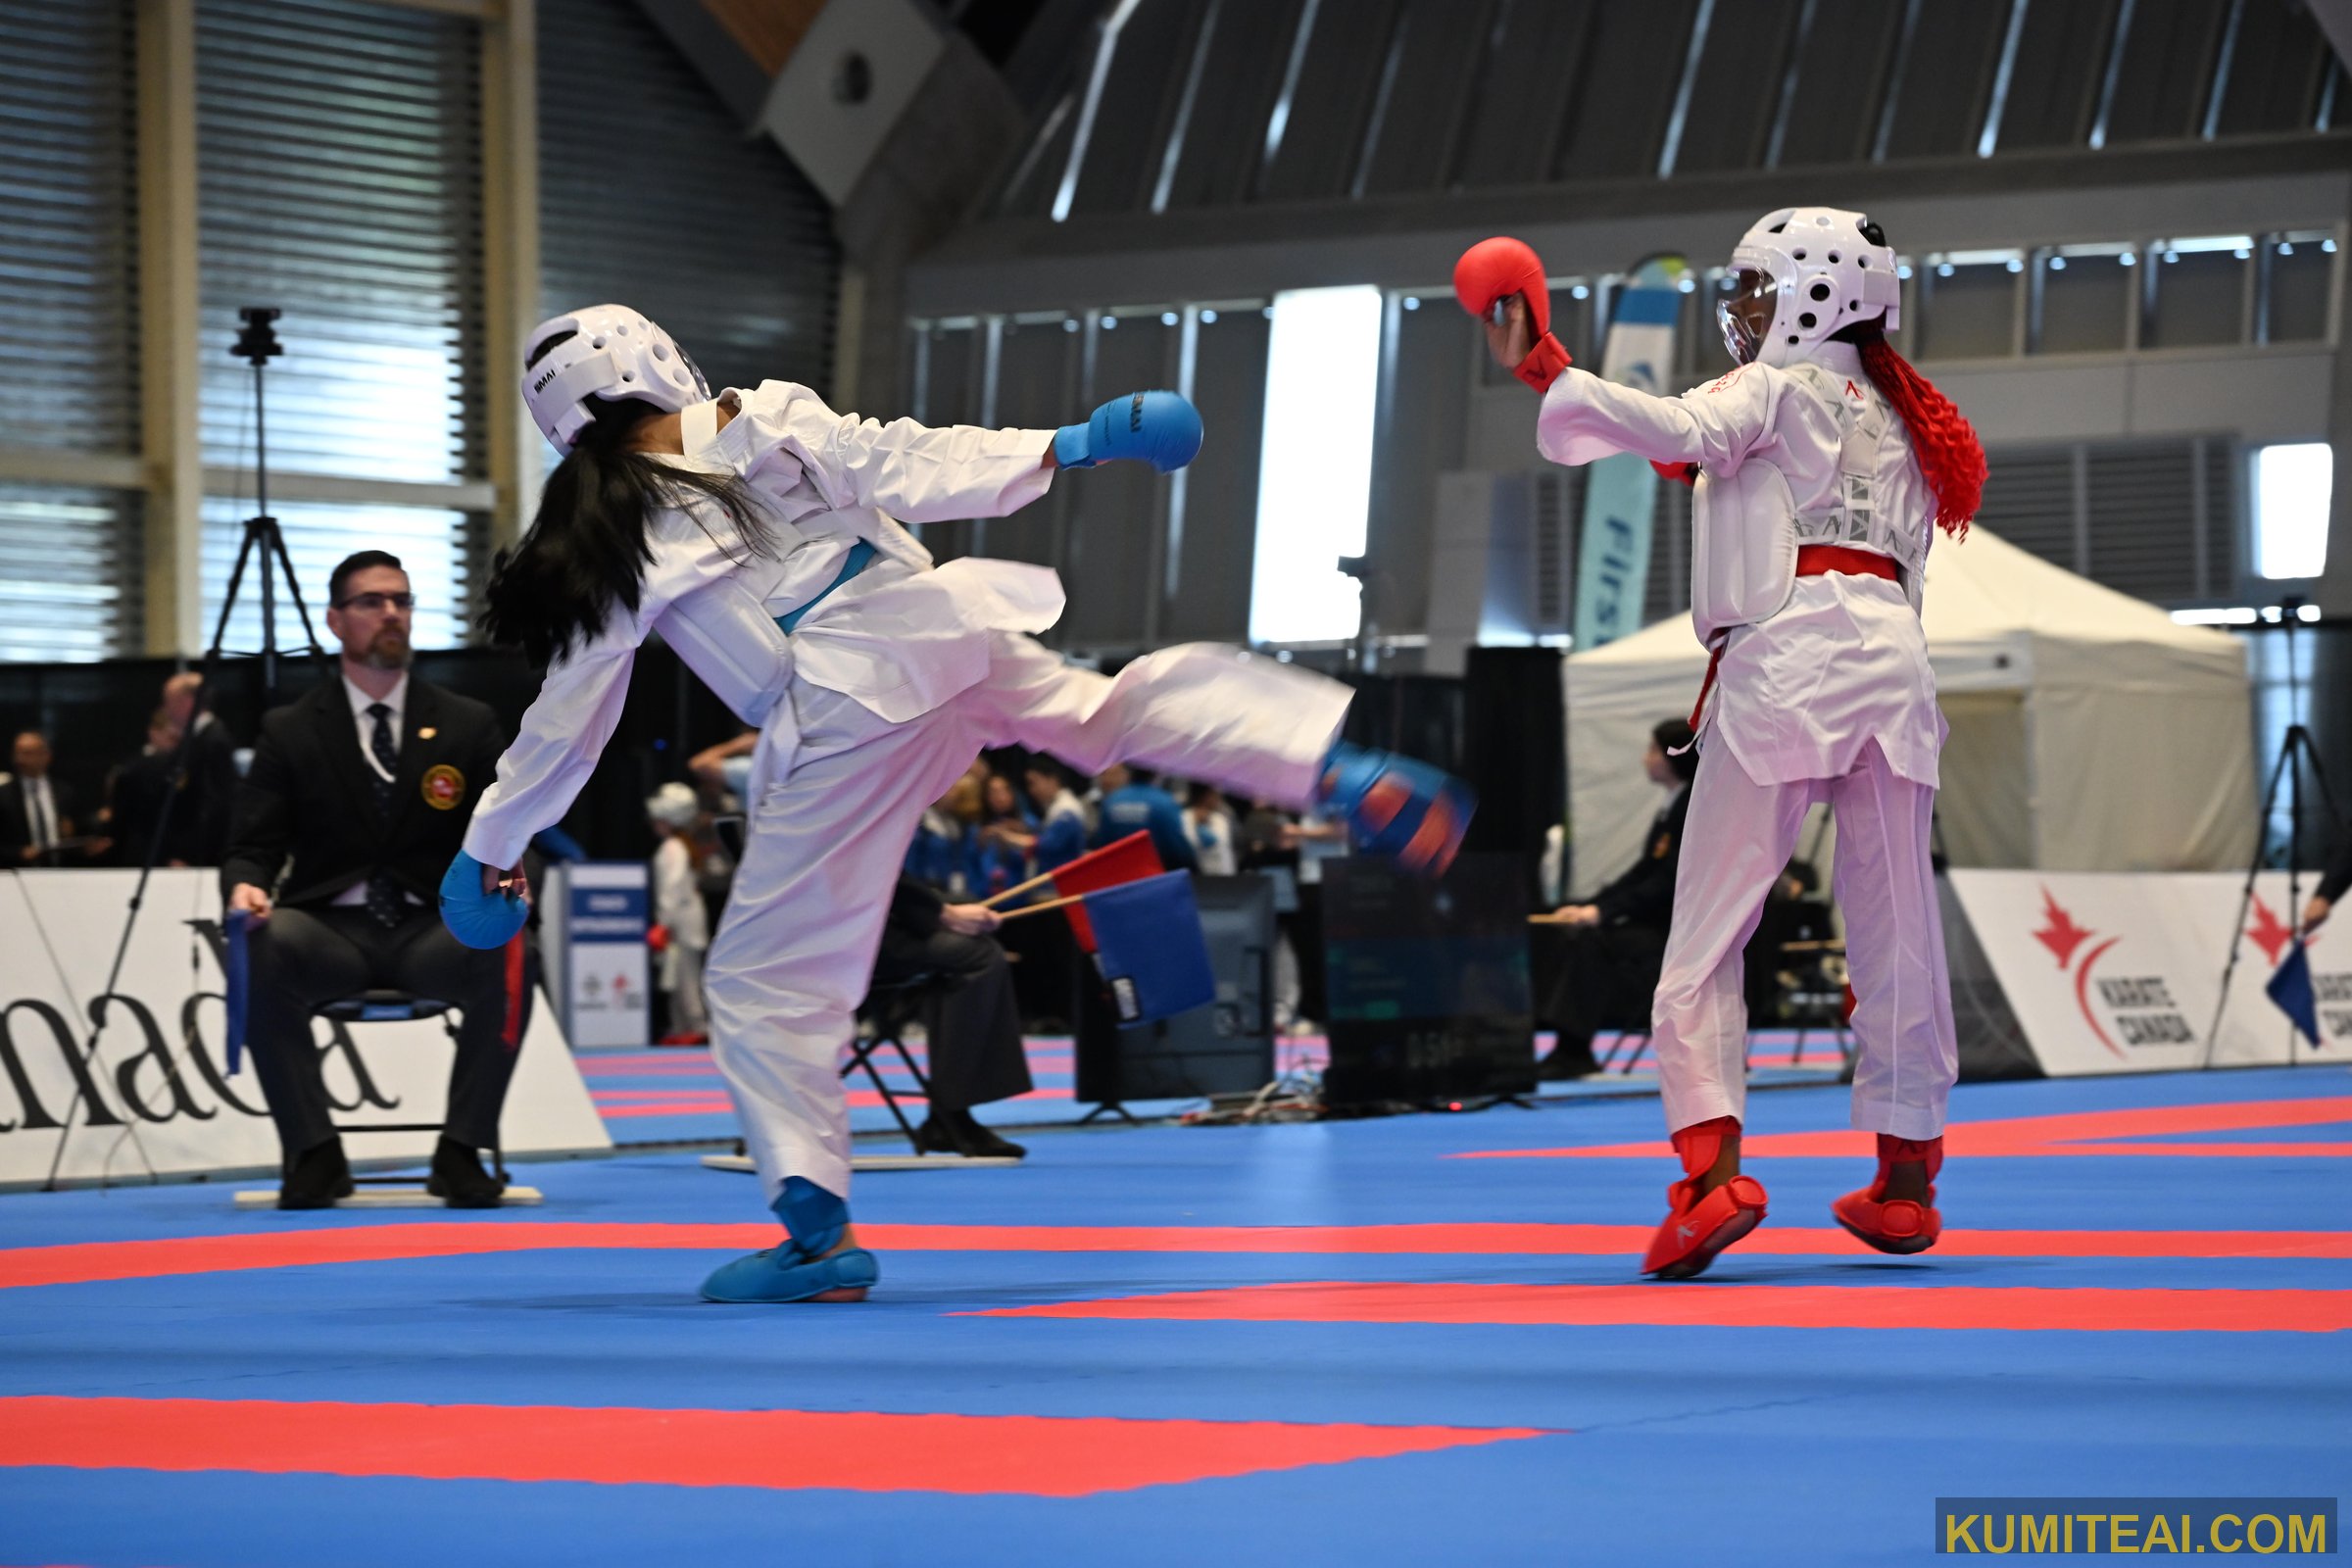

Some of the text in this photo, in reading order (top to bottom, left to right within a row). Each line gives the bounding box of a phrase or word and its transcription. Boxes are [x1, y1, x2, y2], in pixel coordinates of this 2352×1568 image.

[2096, 975, 2177, 1009] KARATE
[0, 918, 402, 1134] nada
[2115, 1014, 2196, 1046] CANADA
